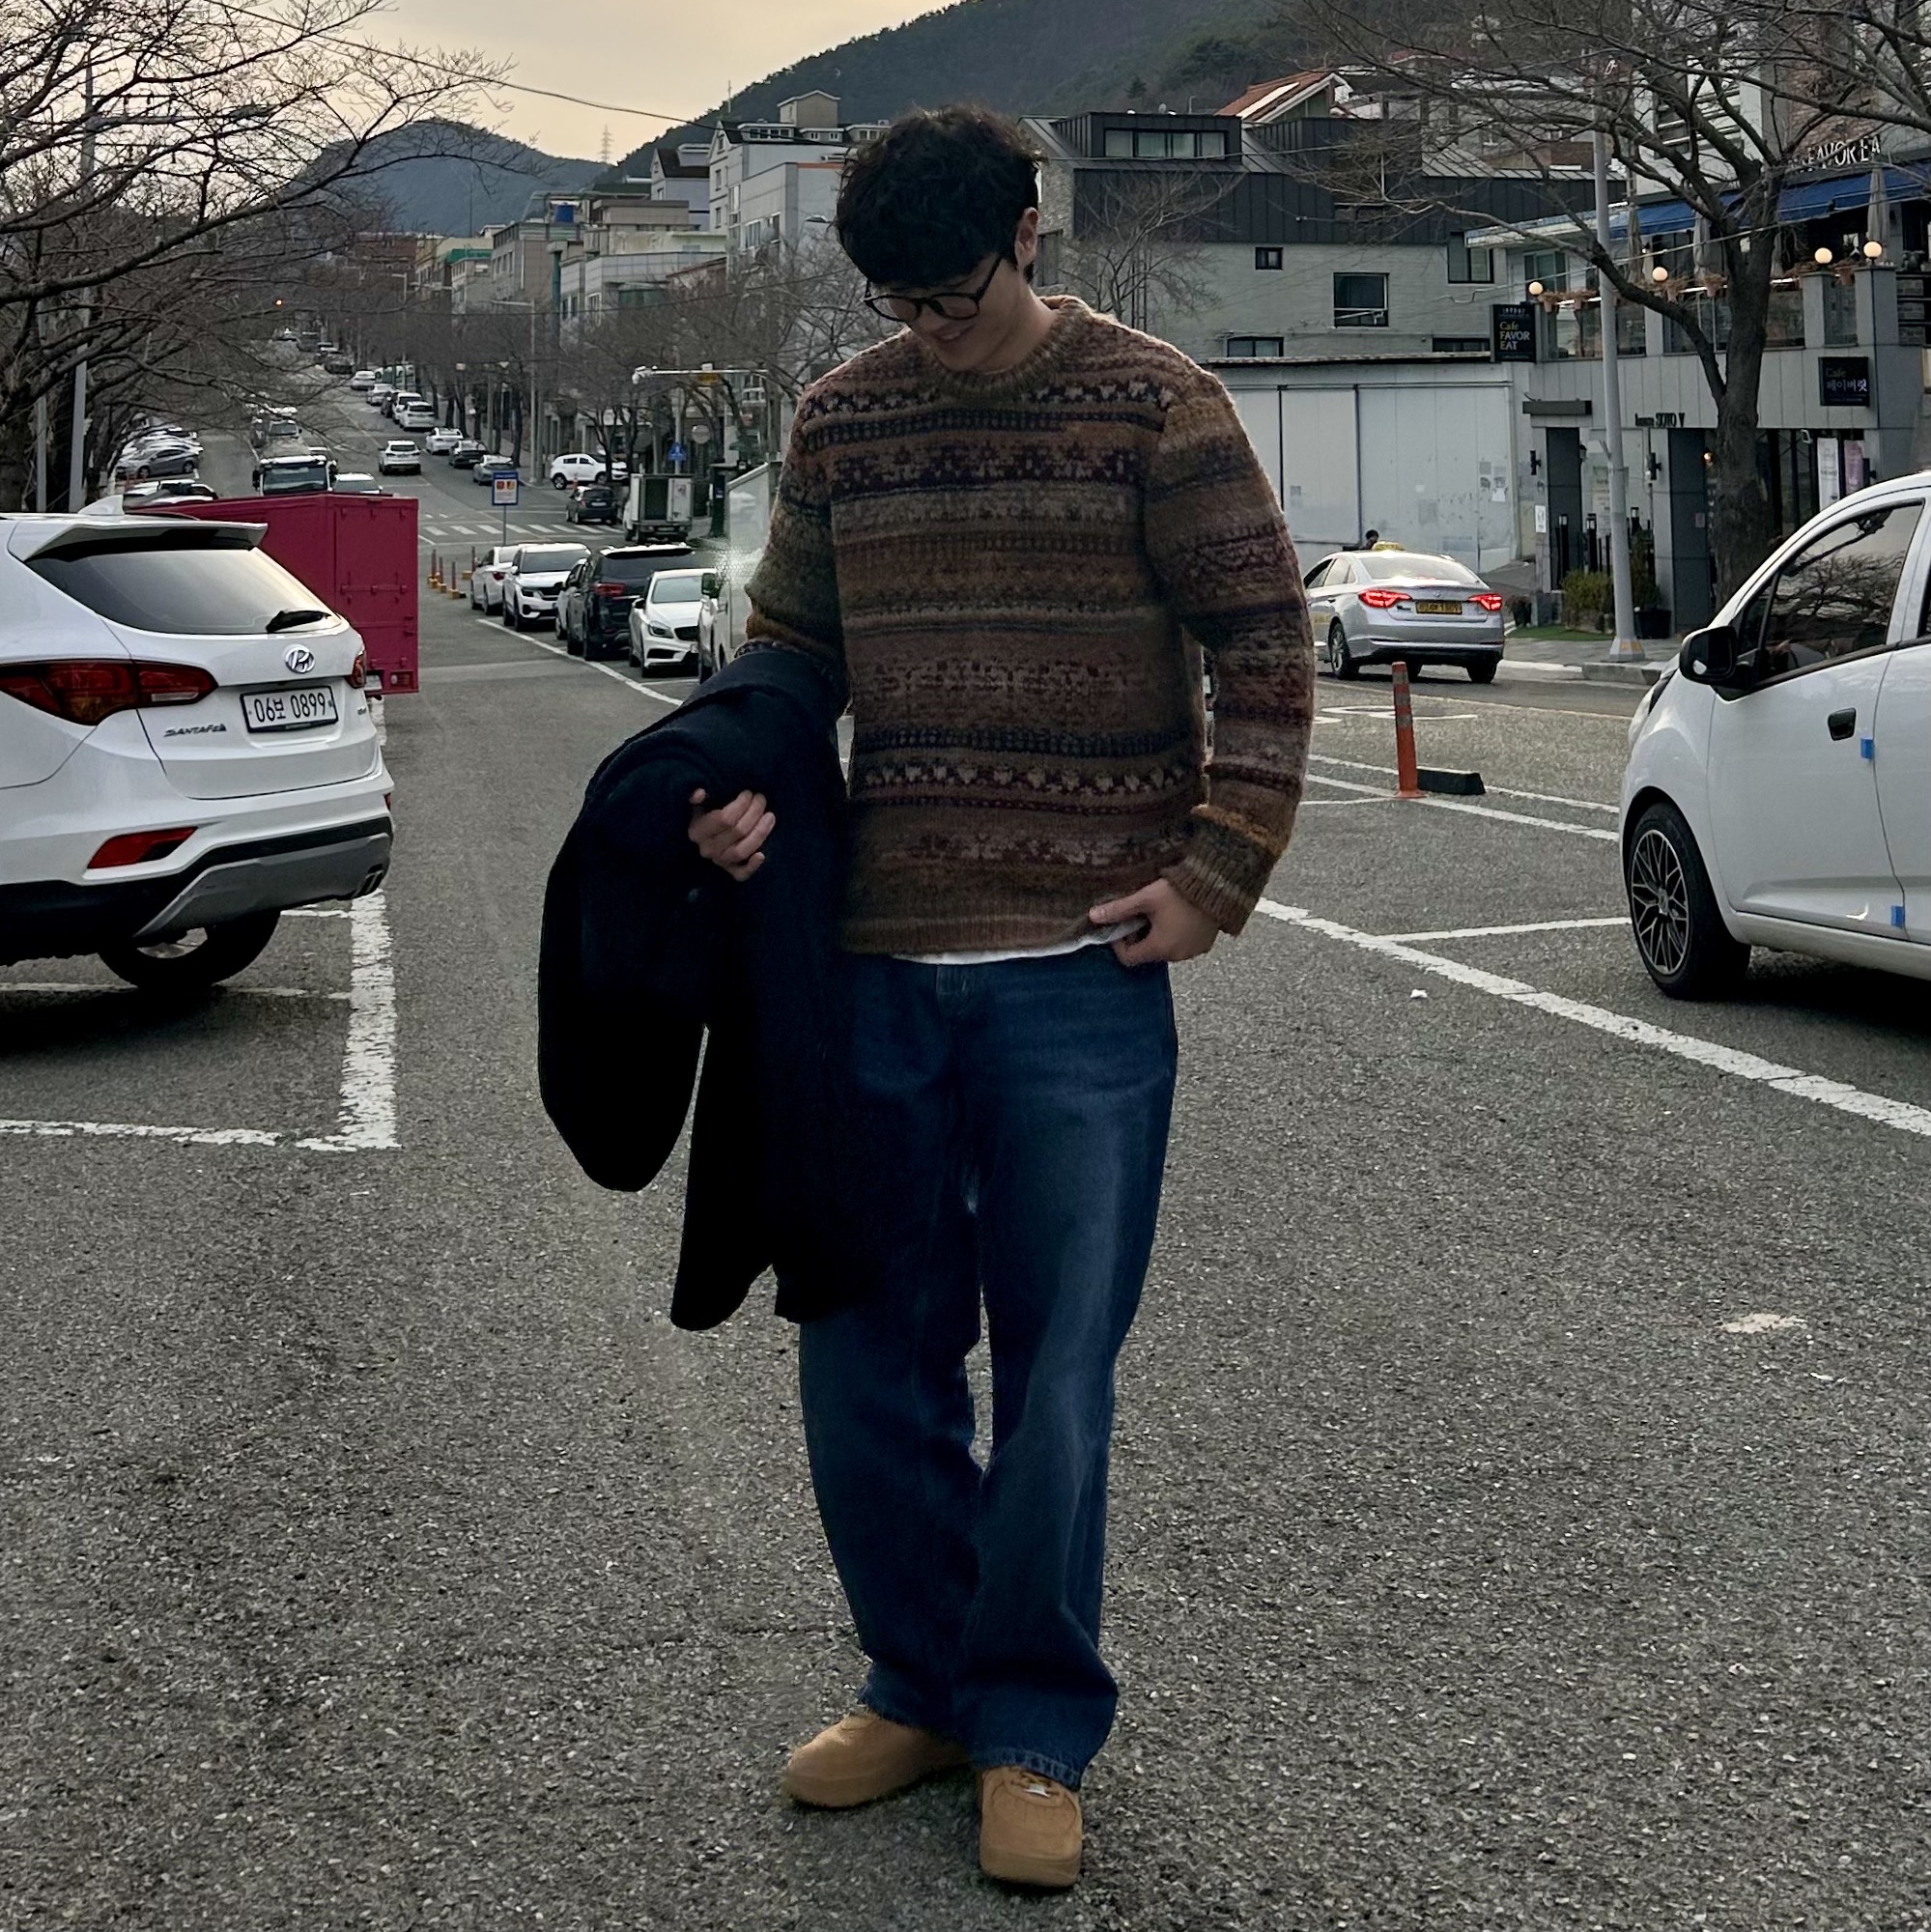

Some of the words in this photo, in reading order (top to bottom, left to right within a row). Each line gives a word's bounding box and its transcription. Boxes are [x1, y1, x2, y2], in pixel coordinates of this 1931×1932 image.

[1499, 321, 1519, 330] Cafe
[1499, 330, 1530, 341] FAVOR
[1499, 340, 1519, 351] EAT
[290, 692, 327, 719] 0899
